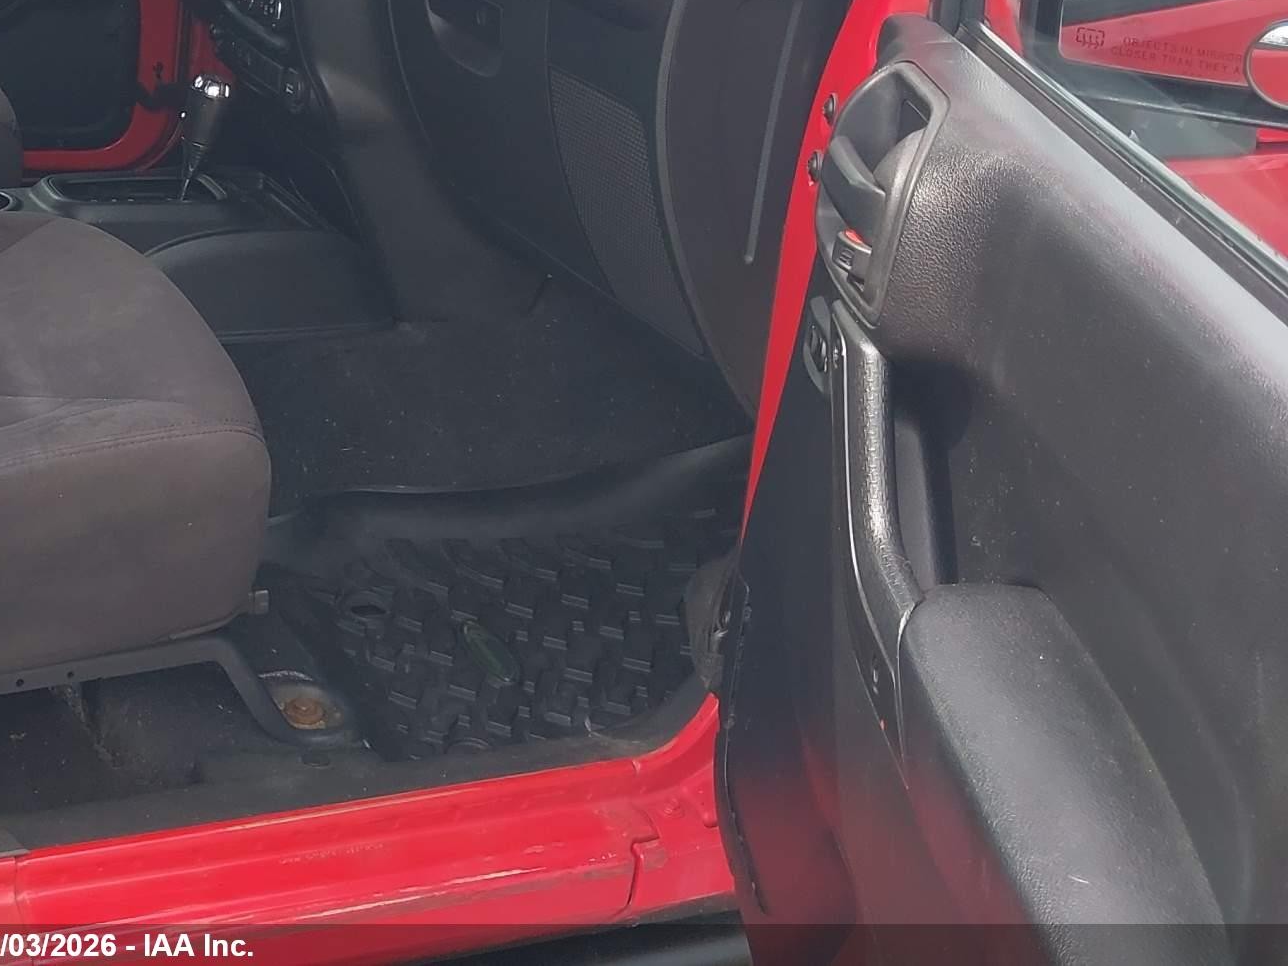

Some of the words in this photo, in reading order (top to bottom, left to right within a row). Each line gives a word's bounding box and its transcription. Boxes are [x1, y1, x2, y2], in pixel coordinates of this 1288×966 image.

[1123, 37, 1177, 53] OBJECTS
[1181, 44, 1193, 55] IN
[1111, 45, 1156, 61] CLOSER
[1161, 53, 1193, 67] THAN
[1199, 59, 1228, 72] THEY
